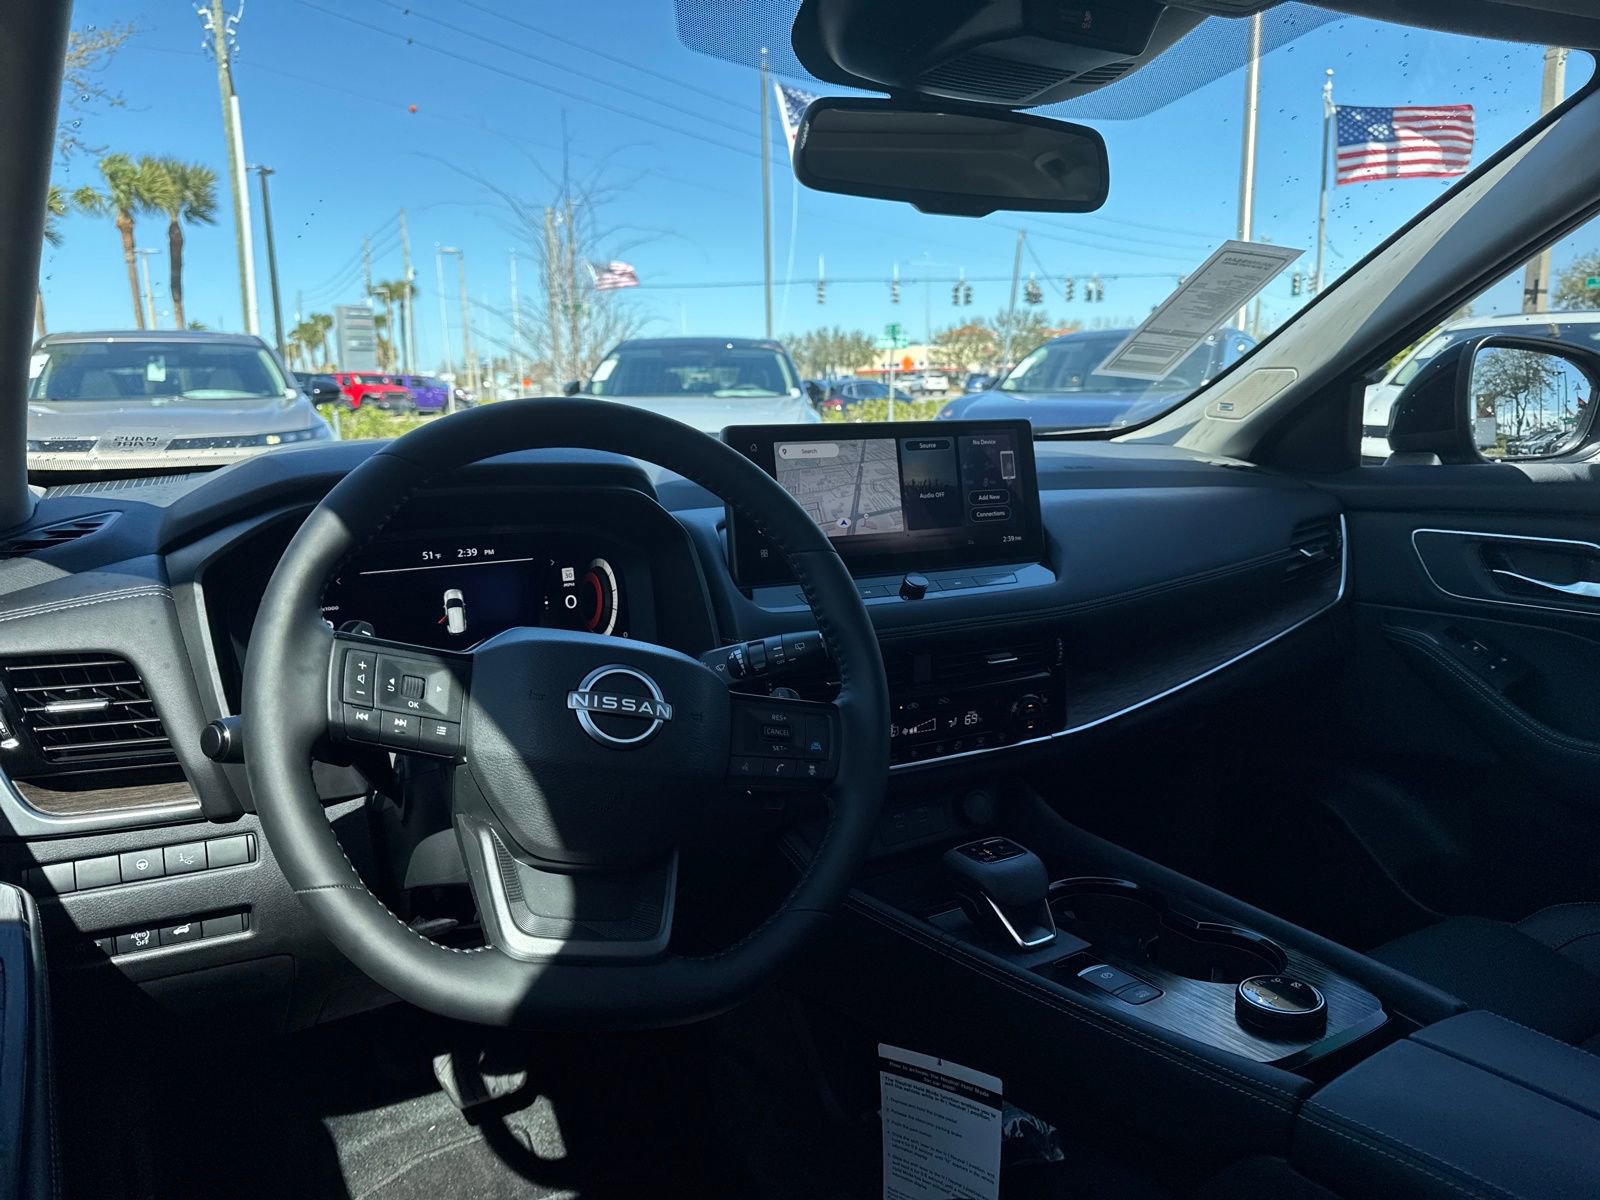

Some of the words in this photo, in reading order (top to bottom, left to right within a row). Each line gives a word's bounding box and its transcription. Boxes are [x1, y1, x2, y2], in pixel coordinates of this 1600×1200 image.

[457, 548, 478, 558] 2:39
[565, 594, 577, 609] 0
[408, 700, 419, 709] OK
[572, 693, 670, 718] NISSAN
[964, 713, 978, 725] 69
[766, 728, 789, 736] CANCEL
[130, 932, 146, 940] AUTO
